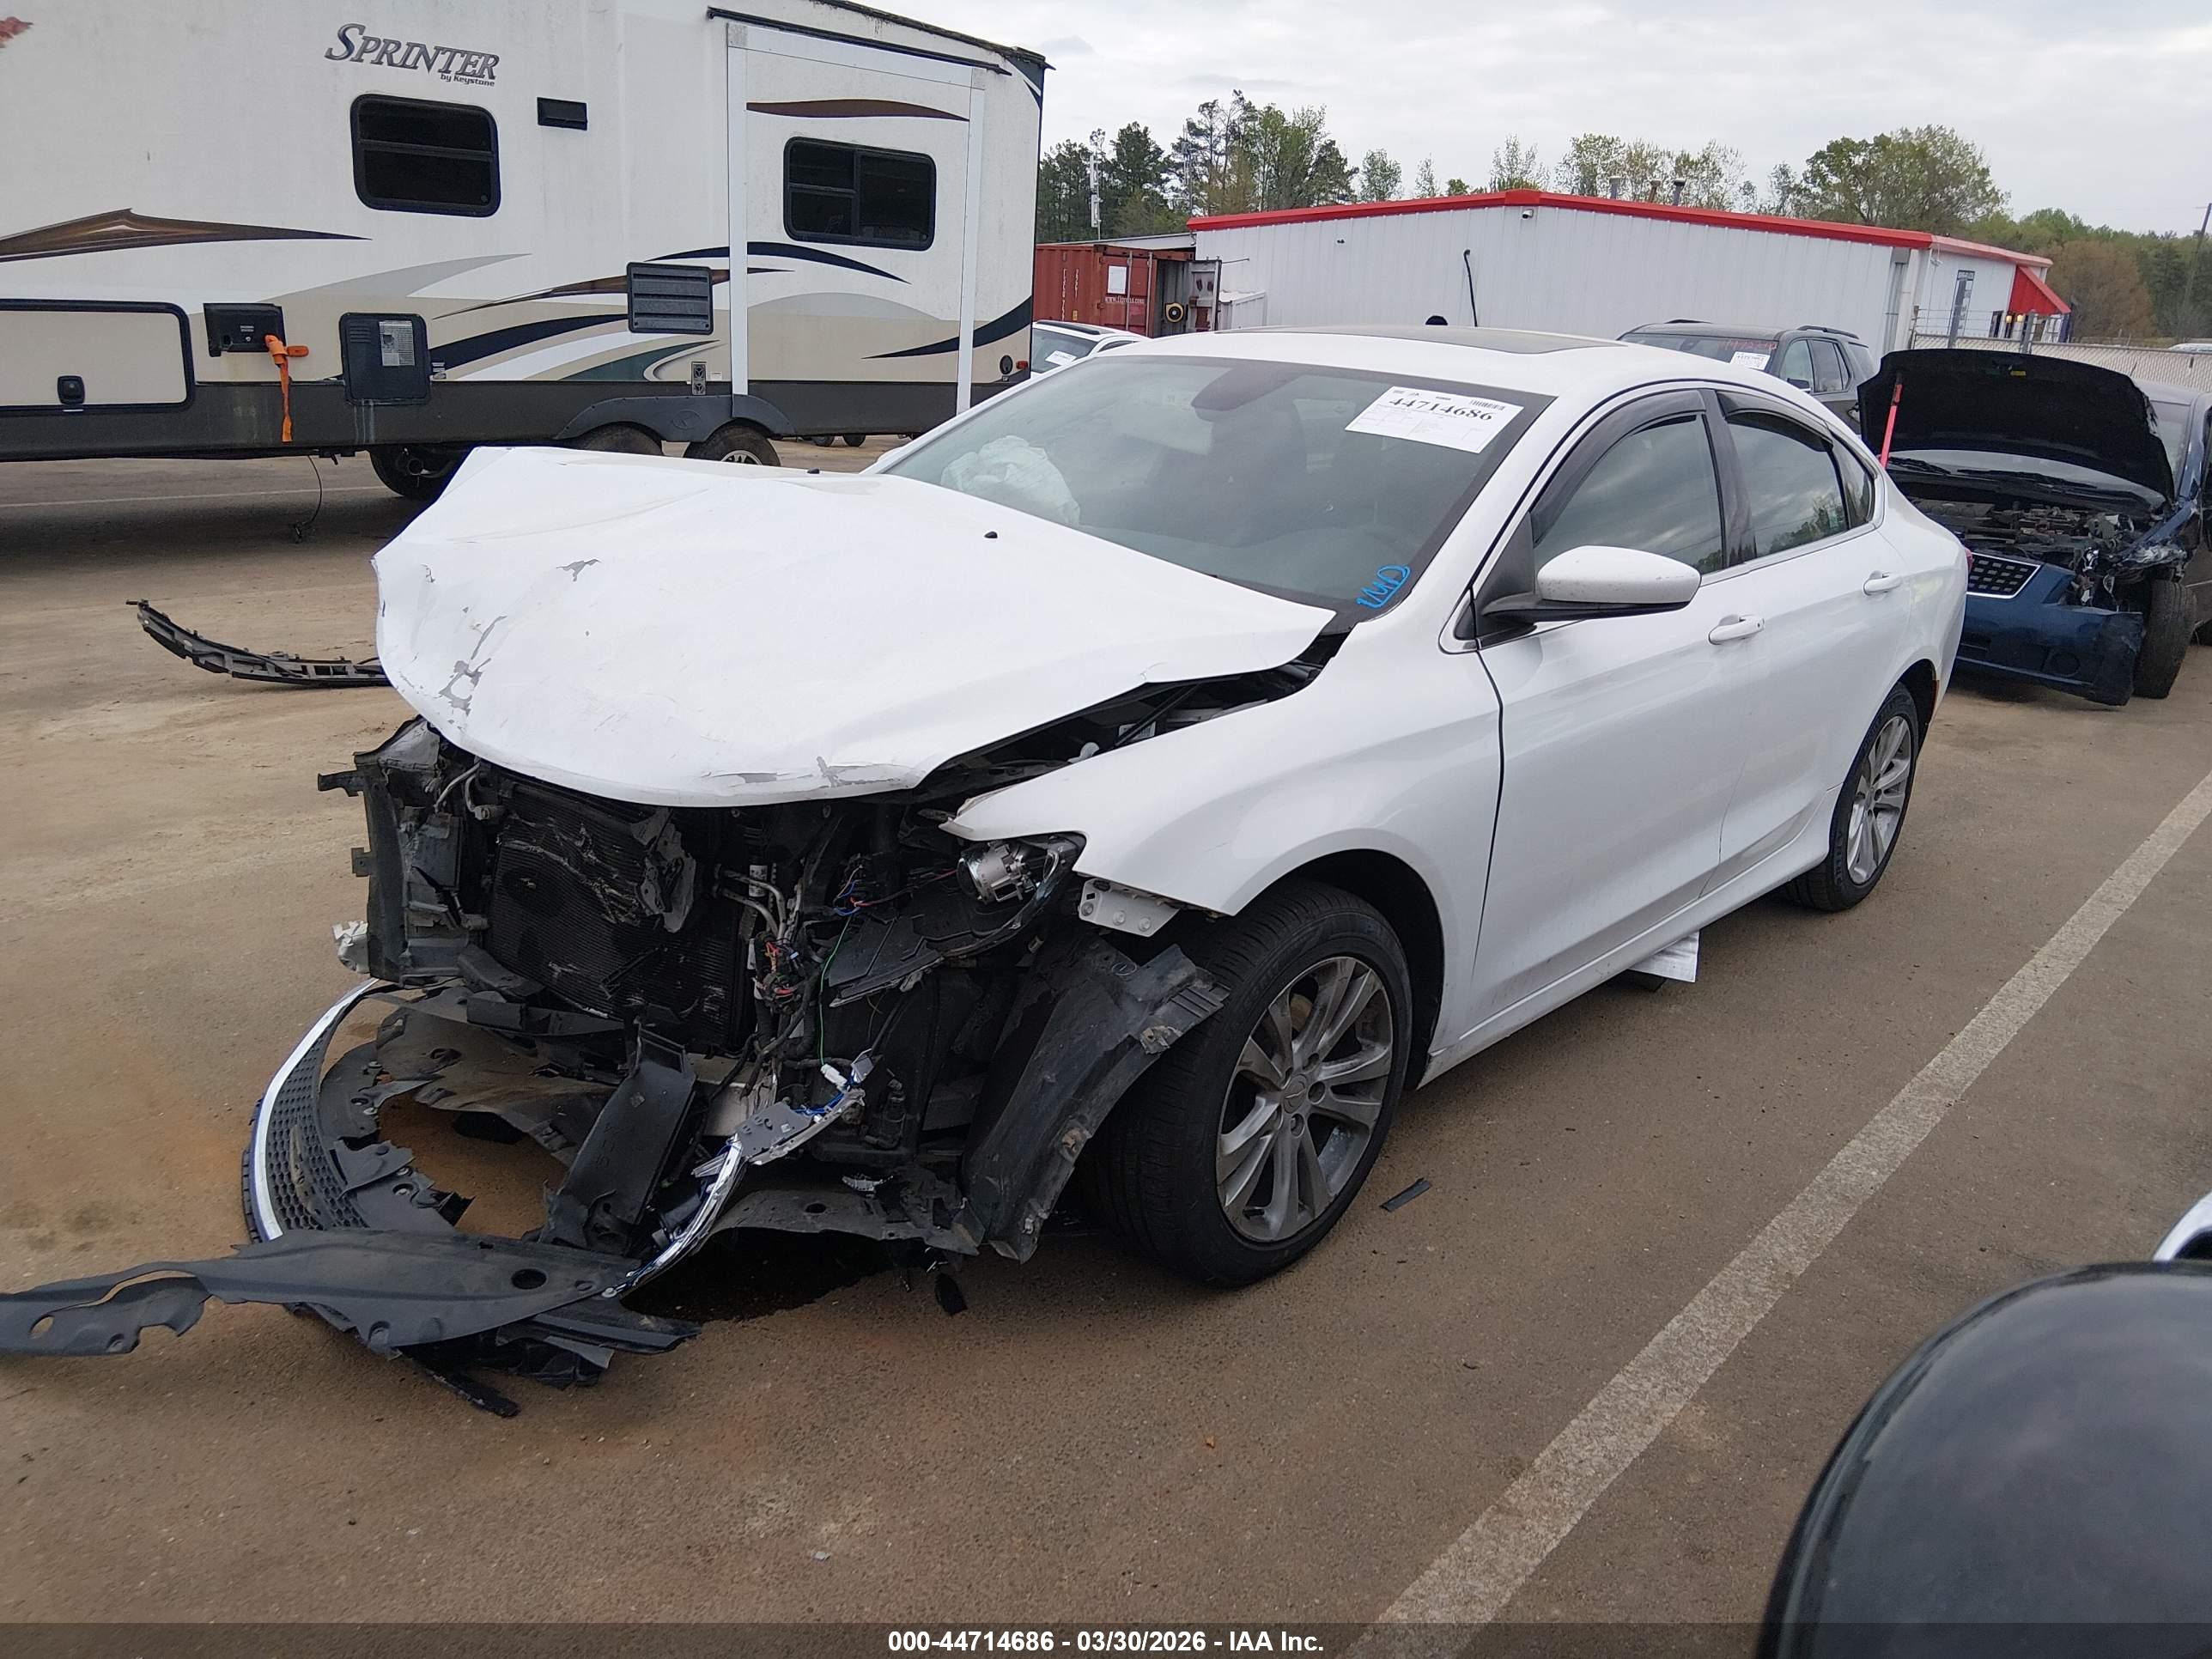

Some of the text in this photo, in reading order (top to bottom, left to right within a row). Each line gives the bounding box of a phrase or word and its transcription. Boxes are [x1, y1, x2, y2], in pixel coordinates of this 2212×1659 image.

[324, 23, 500, 80] SPRINTER
[440, 73, 495, 87] by Keystone
[1389, 398, 1497, 421] 44714686
